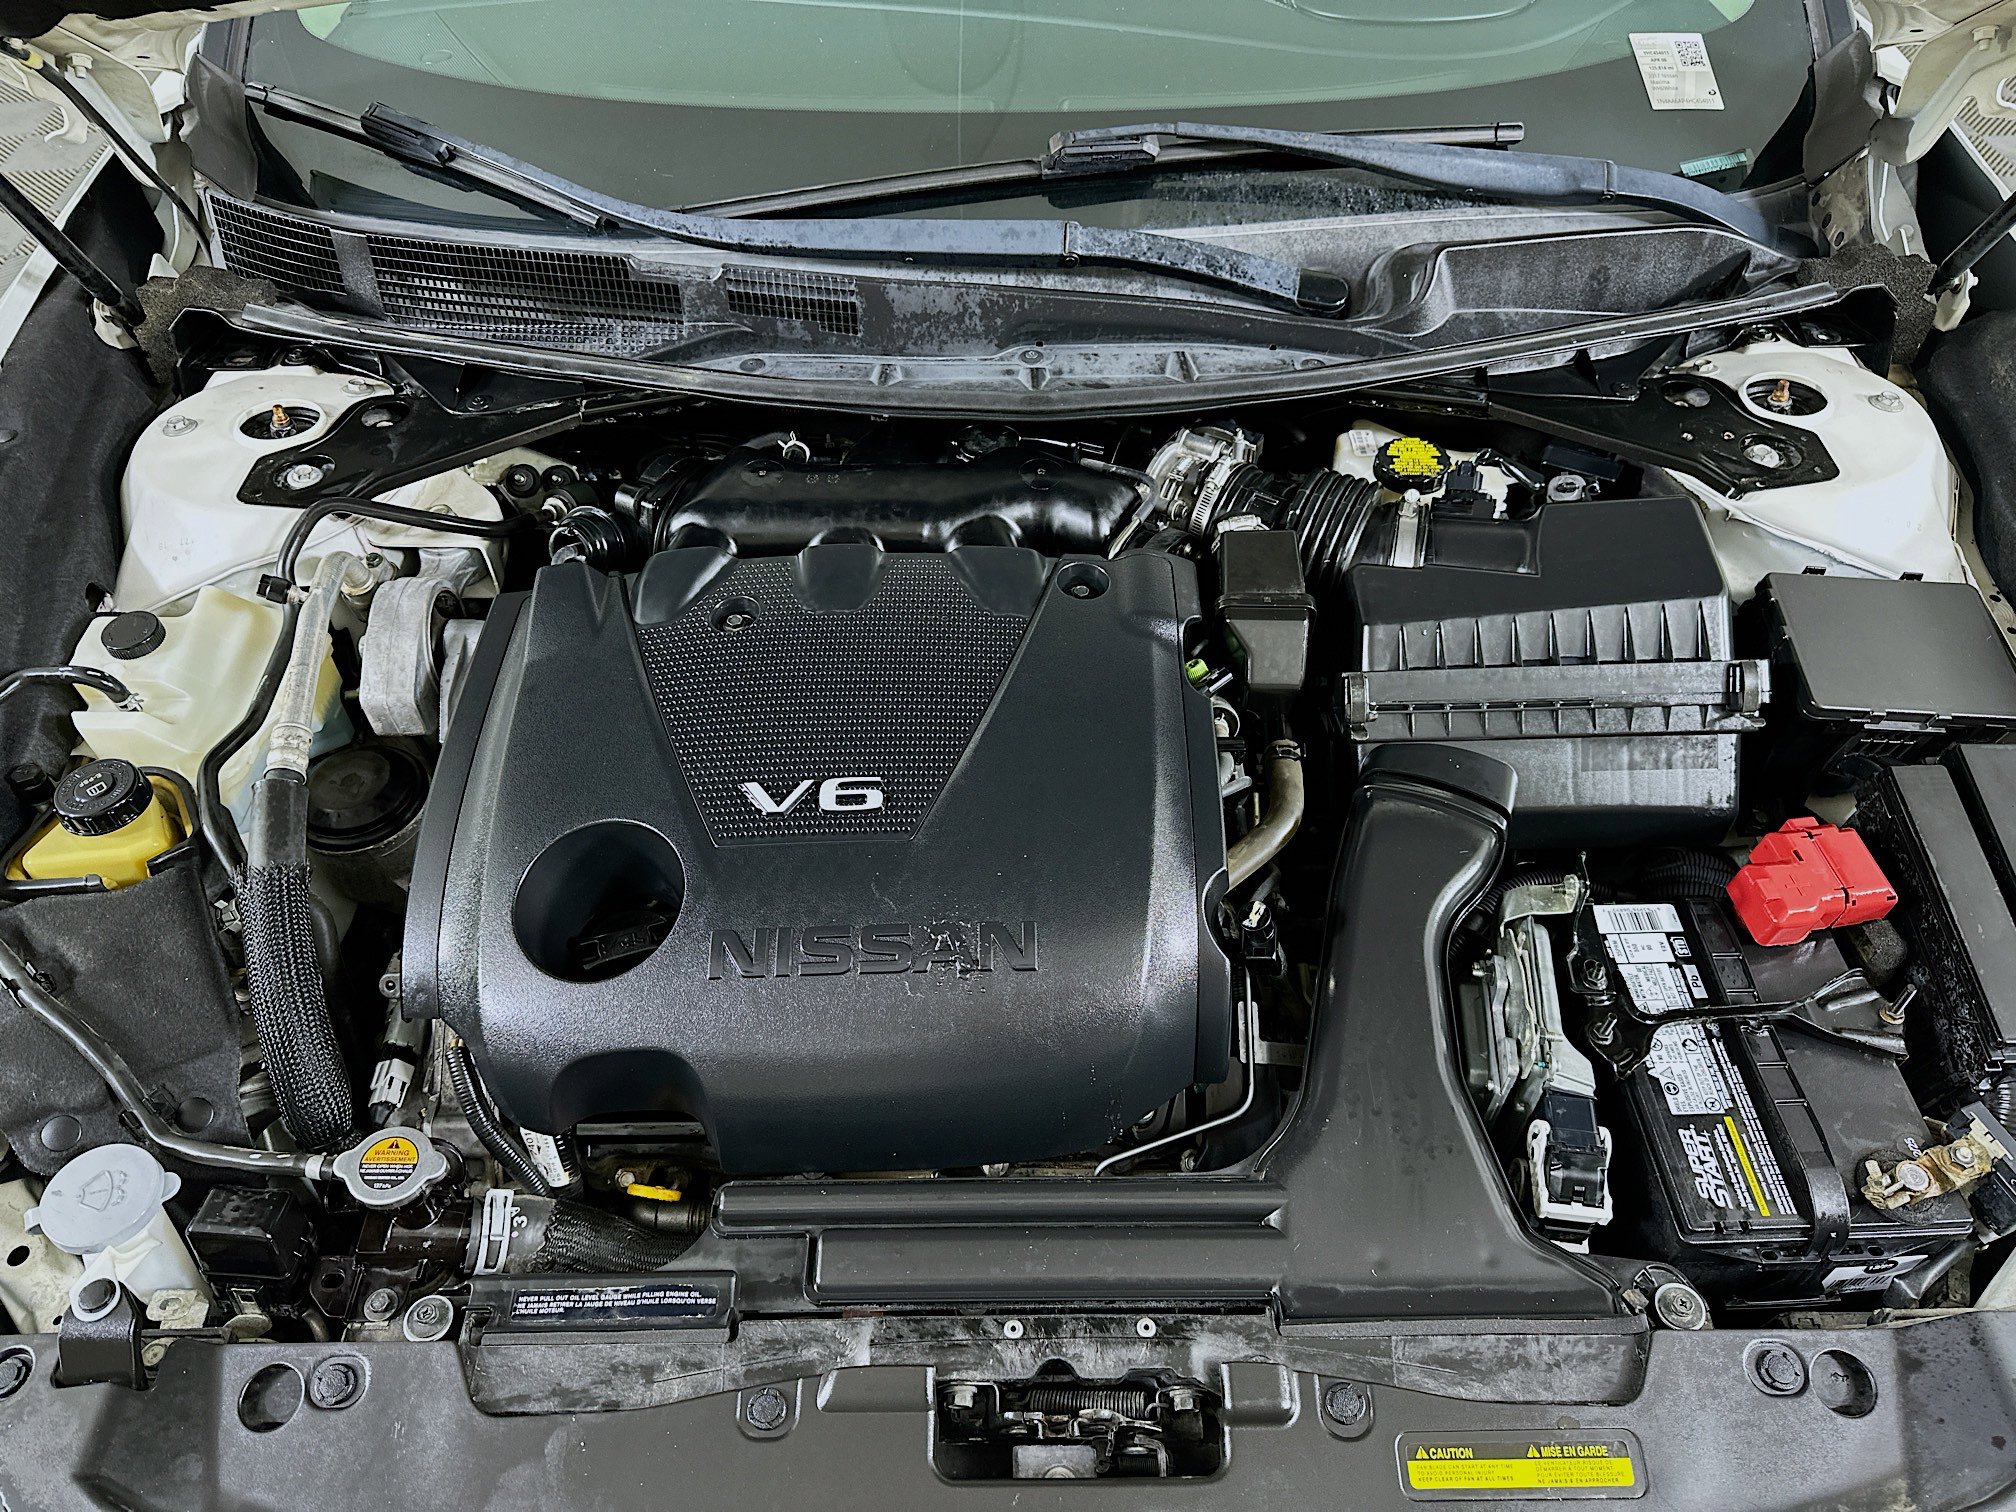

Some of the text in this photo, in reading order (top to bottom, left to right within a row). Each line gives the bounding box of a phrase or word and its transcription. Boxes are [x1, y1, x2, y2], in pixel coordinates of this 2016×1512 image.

[739, 776, 886, 817] V6
[708, 920, 1039, 980] NISSAN
[1691, 975, 1701, 988] Pb
[1672, 1097, 1682, 1112] SHIELD
[1676, 1073, 1695, 1111] EXPLOSIVE GASES
[1678, 1128, 1716, 1200] SUPER
[1695, 1134, 1733, 1209] START
[1429, 1447, 1473, 1459] CAUTION
[1541, 1446, 1608, 1457] MISE EN GARDE
